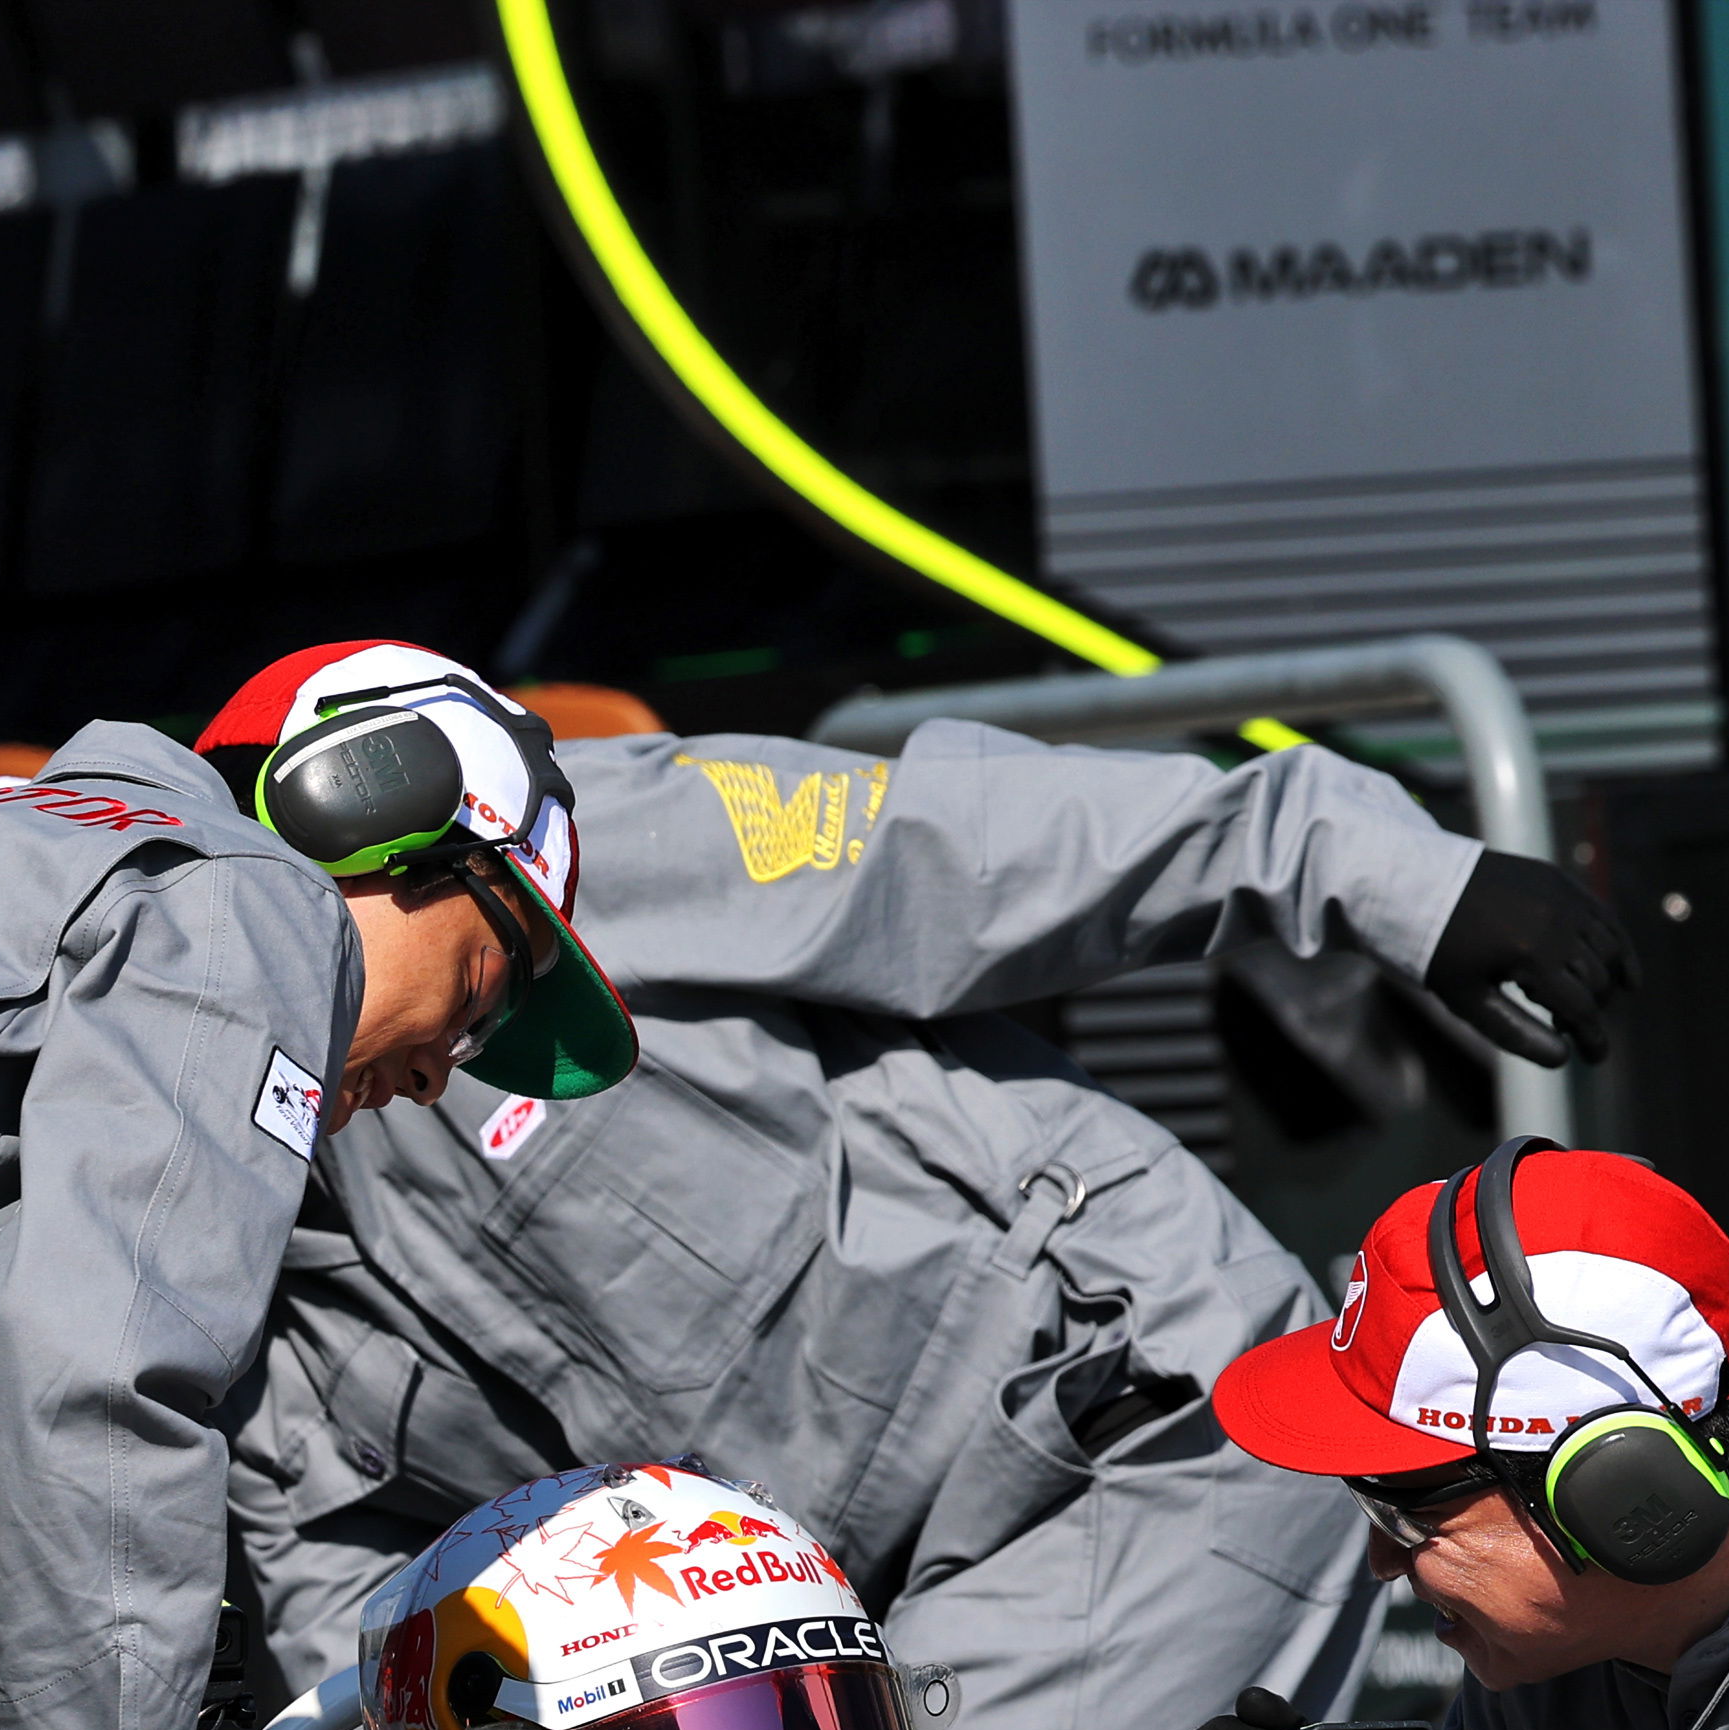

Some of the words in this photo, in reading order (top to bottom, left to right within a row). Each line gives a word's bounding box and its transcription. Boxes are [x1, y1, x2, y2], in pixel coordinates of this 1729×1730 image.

[1088, 6, 1322, 64] FORMULA
[1331, 2, 1437, 50] ONE
[1464, 0, 1597, 46] TEAM
[1229, 226, 1592, 302] MAADEN
[680, 1551, 762, 1600] Red
[759, 1550, 823, 1585] Bull
[560, 1622, 664, 1657] HOND
[651, 1620, 882, 1689] ORACLE
[557, 1685, 606, 1715] Mobil
